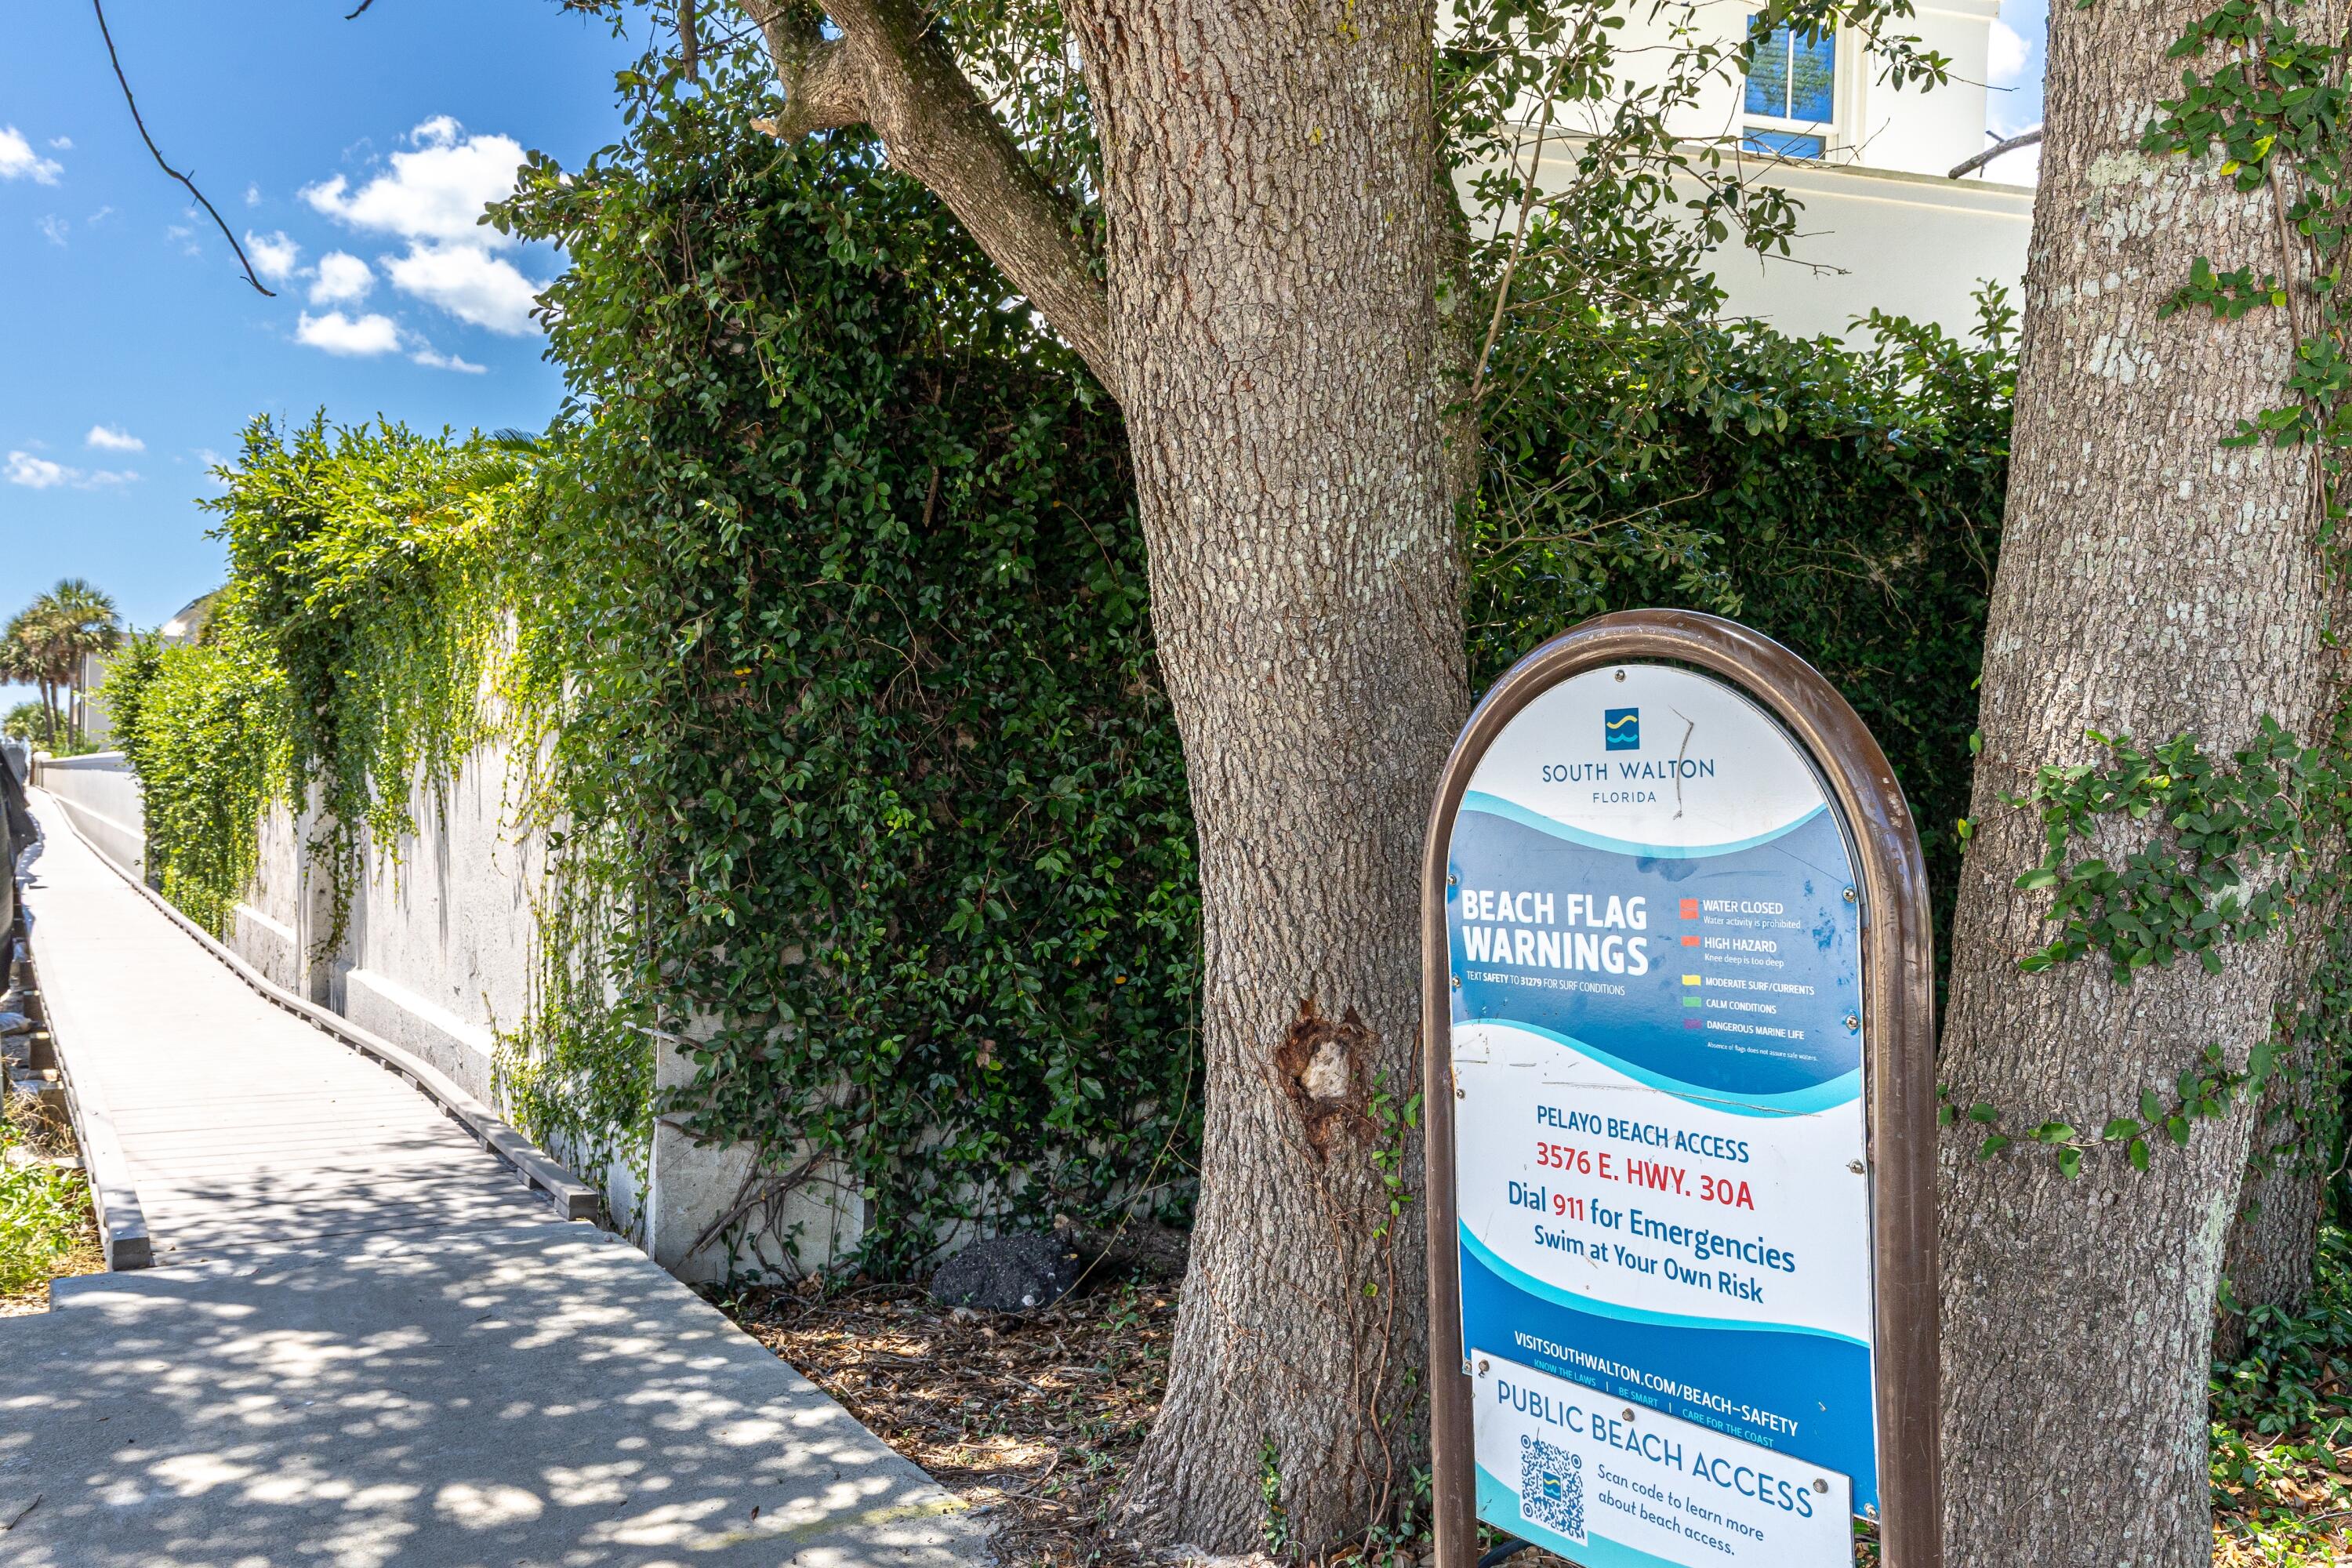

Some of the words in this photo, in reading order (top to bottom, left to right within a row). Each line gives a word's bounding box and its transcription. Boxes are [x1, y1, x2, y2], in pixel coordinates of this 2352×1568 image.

[1543, 763, 1607, 782] SOUTH
[1620, 759, 1715, 779] WALTON
[1593, 791, 1656, 803] FLORIDA
[1461, 890, 1555, 924] BEACH
[1567, 893, 1647, 930] FLAG
[1703, 900, 1738, 912] WATER
[1740, 902, 1783, 914] CLOSED
[1704, 916, 1724, 924] Water
[1726, 917, 1752, 928] activity
[1755, 918, 1760, 927] is
[1762, 919, 1801, 929] prohibited
[1461, 925, 1649, 976] WARNINGS
[1704, 937, 1730, 949] HIGH
[1733, 939, 1777, 953] HAZARD
[1724, 955, 1742, 965] deep
[1744, 956, 1750, 964] is
[1751, 956, 1763, 965] too
[1766, 957, 1784, 968] deep
[1467, 971, 1483, 980] TEXT
[1483, 973, 1508, 983] SAFETY
[1510, 975, 1519, 985] TO
[1521, 976, 1541, 987] 31279
[1544, 978, 1558, 989] FOR
[1559, 980, 1578, 990] SURF
[1580, 982, 1625, 995] CONDITIONS
[1706, 978, 1747, 989] MODERATE
[1748, 981, 1815, 995] SURF/CURRENTS
[1707, 999, 1727, 1009] CALM
[1730, 1001, 1777, 1014] CONDITIONS
[1707, 1021, 1754, 1033] DANGEROUS
[1755, 1026, 1786, 1037] MARINE
[1788, 1030, 1805, 1040] LIFE
[1734, 1044, 1746, 1053] flags
[1537, 1105, 1602, 1135] PELAYO
[1608, 1117, 1668, 1148] BEACH
[1675, 1131, 1750, 1163] ACCESS
[1537, 1142, 1591, 1174] 3576
[1599, 1152, 1619, 1181] E.
[1627, 1158, 1691, 1196] HWY.
[1700, 1175, 1755, 1210] 30A
[1508, 1181, 1546, 1212] Dial
[1553, 1193, 1584, 1221] 911
[1591, 1199, 1623, 1230] for
[1630, 1209, 1795, 1273] Emergencies
[1535, 1225, 1584, 1255] Swim
[1590, 1241, 1609, 1261] at
[1613, 1244, 1658, 1275] Your
[1664, 1258, 1711, 1290] Own
[1719, 1271, 1763, 1304] Risk
[1514, 1330, 1798, 1437] VISITSOUTHWALTON.COM/BEACH-SAFETY
[1534, 1359, 1557, 1373] KNOW
[1559, 1367, 1573, 1380] THE
[1574, 1373, 1596, 1387] LAWS
[1618, 1387, 1628, 1397] BE
[1631, 1391, 1658, 1407] SMART
[1682, 1409, 1704, 1424] CARE
[1706, 1417, 1723, 1430] FOR
[1726, 1424, 1742, 1437] THE
[1744, 1431, 1773, 1447] COAST
[1498, 1379, 1584, 1433] PUBLIC
[1592, 1413, 1682, 1471] BEACH
[1693, 1451, 1813, 1519] ACCESS
[1598, 1464, 1628, 1489] Scan
[1632, 1480, 1664, 1503] code
[1668, 1491, 1682, 1509] to
[1686, 1497, 1722, 1526] learn
[1726, 1518, 1764, 1541] more
[1598, 1493, 1637, 1517] about
[1640, 1504, 1681, 1534] beach
[1684, 1525, 1736, 1556] access.
